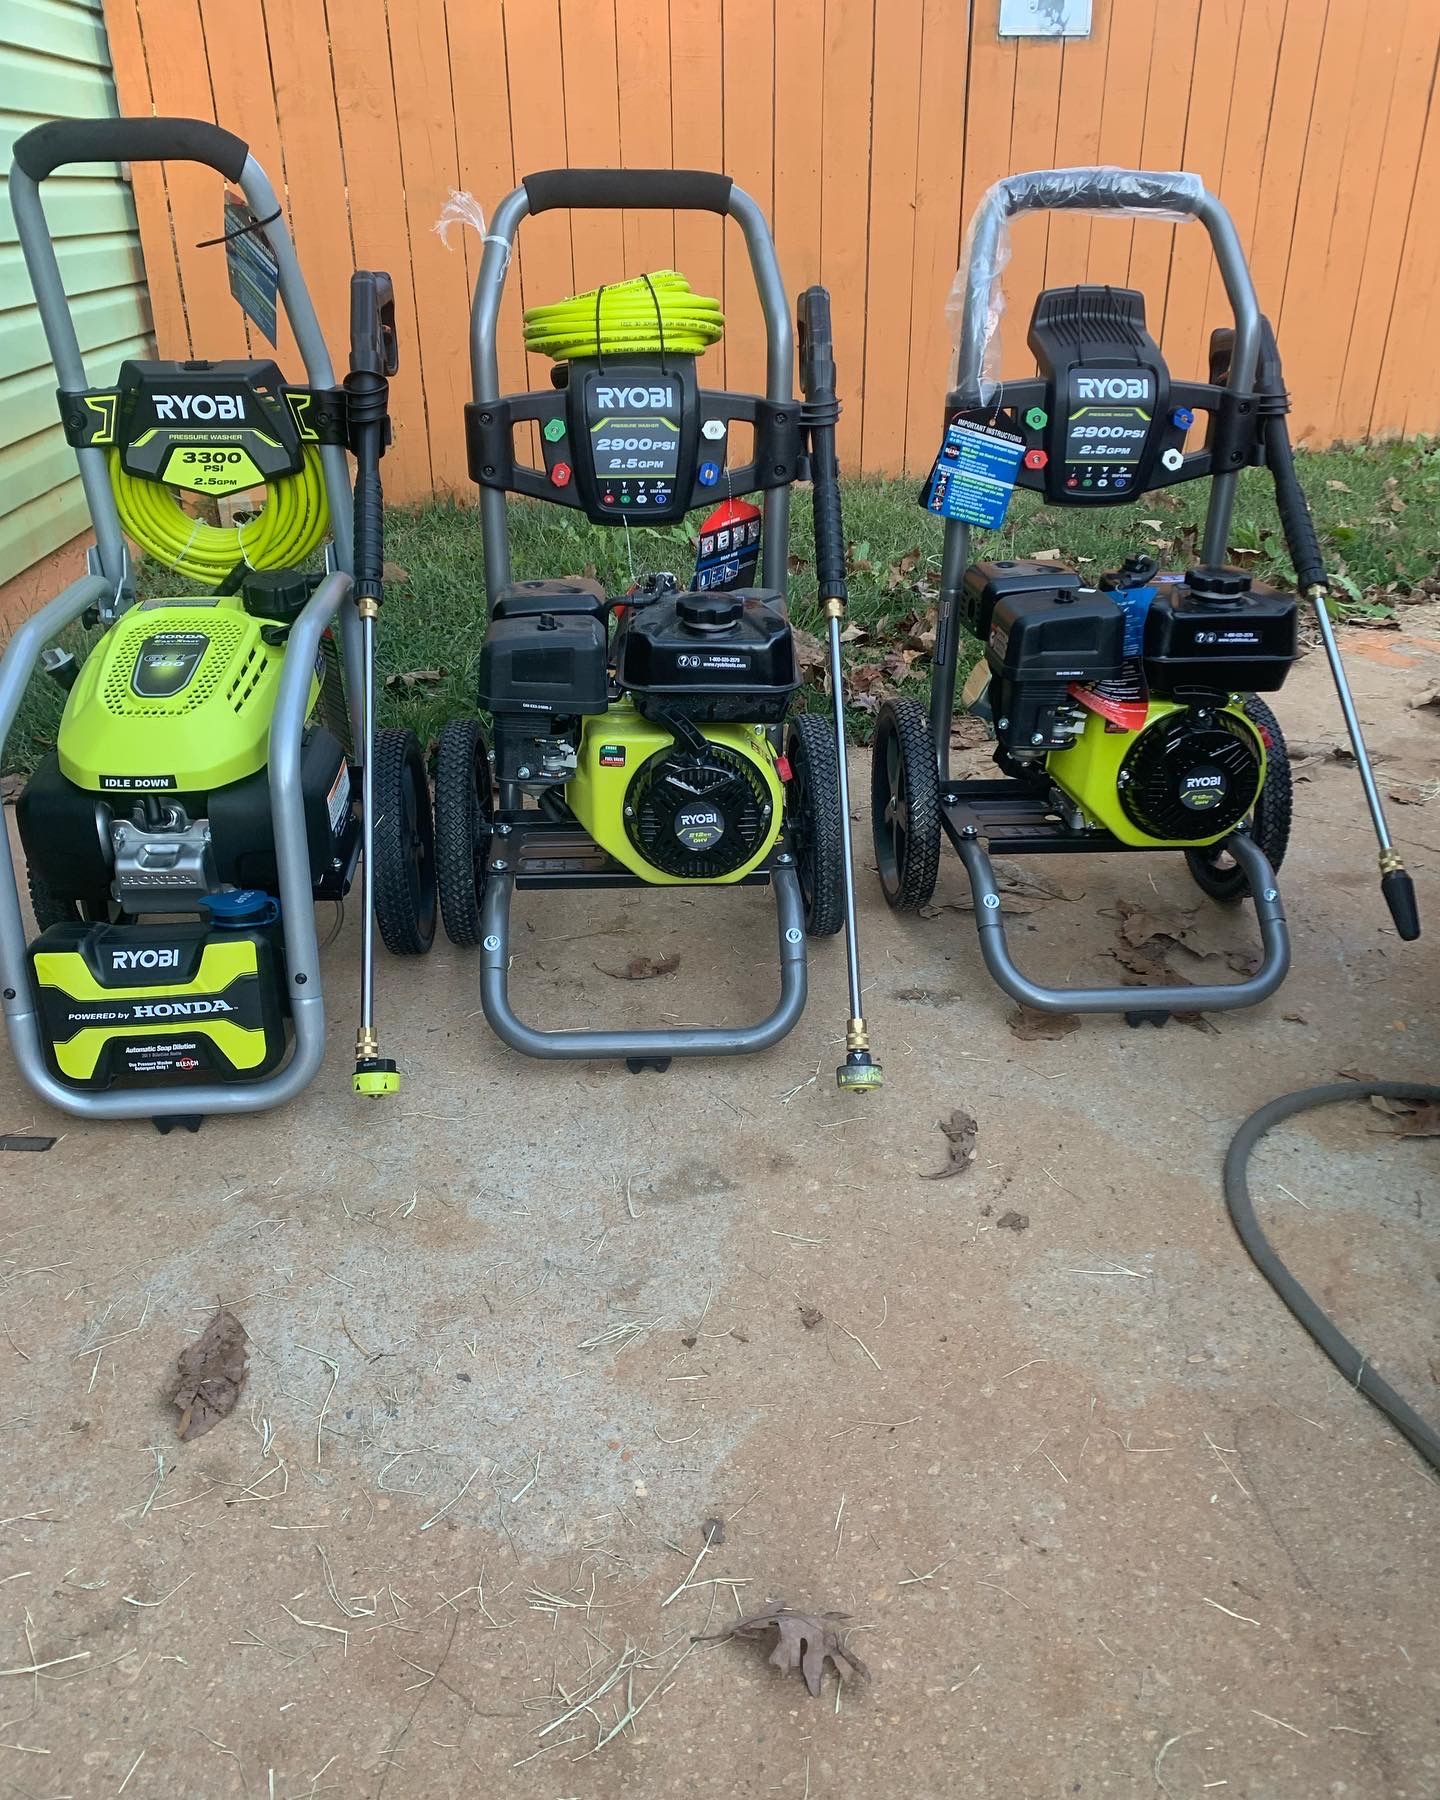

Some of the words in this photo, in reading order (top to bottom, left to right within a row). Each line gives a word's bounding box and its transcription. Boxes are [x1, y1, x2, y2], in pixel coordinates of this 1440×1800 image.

[1078, 378, 1149, 399] RYOBI
[596, 387, 673, 408] RYOBI
[152, 394, 246, 420] RYOBI
[957, 418, 986, 433] IMPORTANT
[986, 425, 1023, 443] INSTRUCTIONS
[1070, 426, 1146, 438] 2900PSI
[596, 438, 676, 451] 2900PSI
[182, 452, 242, 463] 3300
[193, 477, 237, 486] 2.5GPM
[105, 778, 131, 787] IDLE
[134, 778, 169, 788] DOWN
[1186, 776, 1221, 788] RYOBI
[680, 812, 717, 825] RYOBI
[112, 949, 180, 969] RYOBI
[68, 1012, 116, 1021] POWERED
[117, 1012, 130, 1020] by
[132, 999, 234, 1019] HONDA
[125, 1045, 156, 1054] Automatic
[172, 1043, 196, 1051] Dilution
